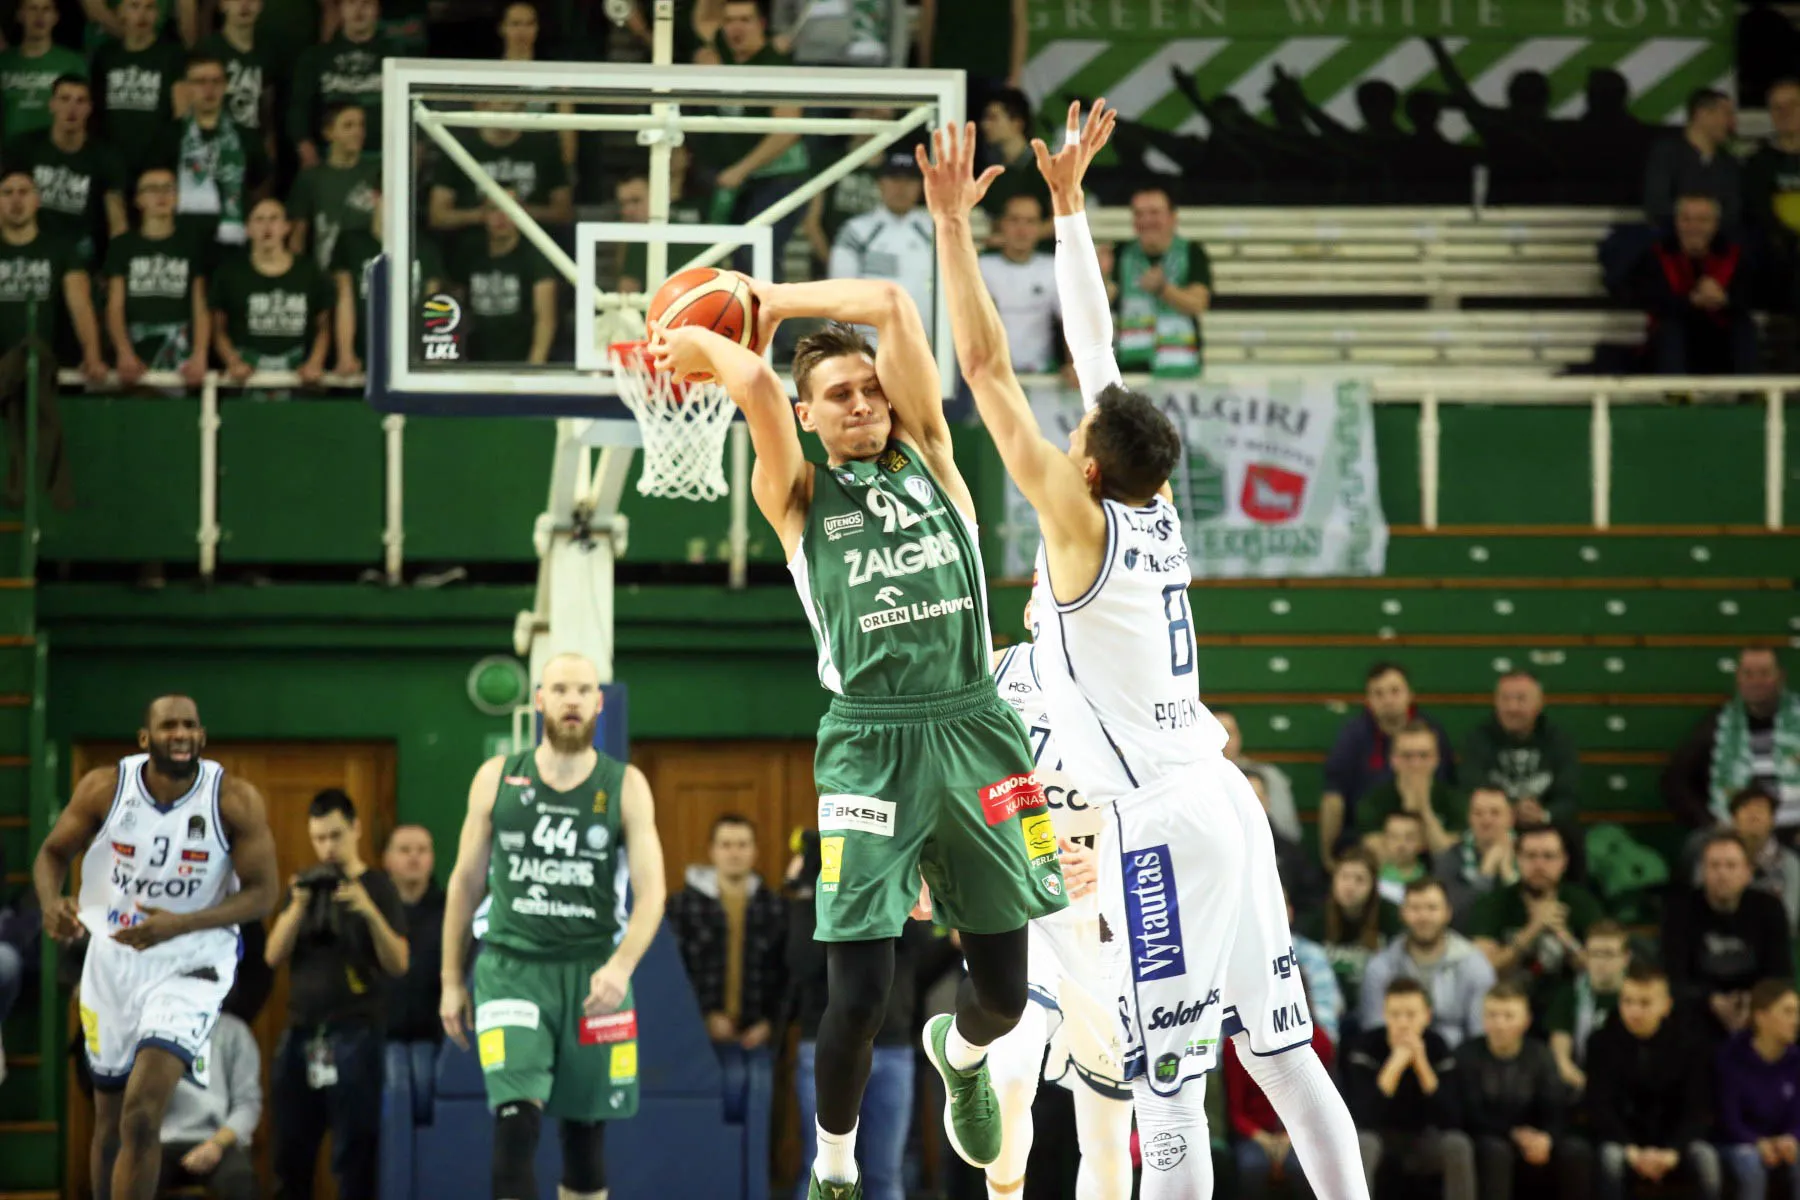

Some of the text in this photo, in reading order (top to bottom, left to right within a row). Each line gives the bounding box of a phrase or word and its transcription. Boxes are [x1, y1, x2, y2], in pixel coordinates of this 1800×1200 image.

[1027, 0, 1724, 30] GREEN WHITE BOYS
[425, 343, 460, 360] LKL
[826, 515, 861, 531] UTENOS
[863, 596, 974, 629] ORLEN Lietuva
[1162, 583, 1194, 677] 8
[531, 814, 578, 857] 44
[149, 836, 170, 867] 3
[1129, 851, 1181, 977] Vytautas
[1144, 1144, 1188, 1158] SKYCOP
[1157, 1157, 1172, 1166] BC
